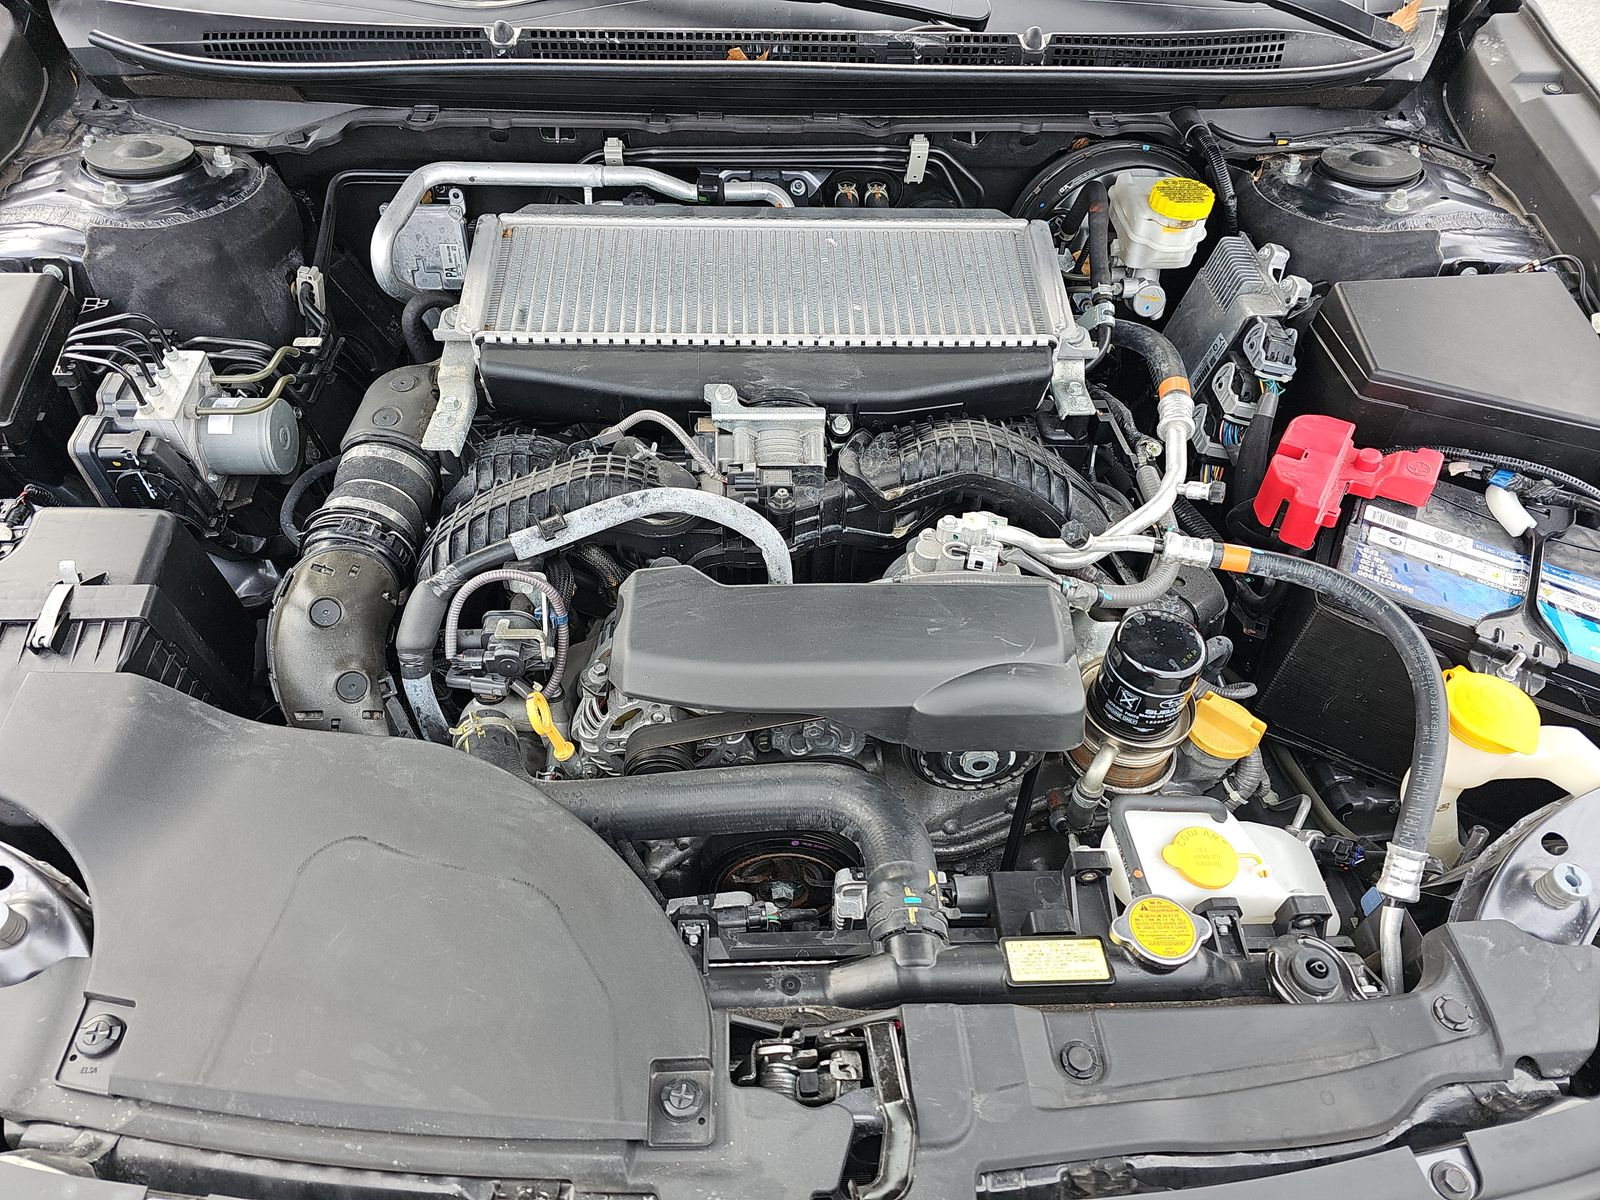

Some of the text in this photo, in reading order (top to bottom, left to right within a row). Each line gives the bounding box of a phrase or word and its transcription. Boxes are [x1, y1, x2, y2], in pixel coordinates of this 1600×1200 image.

[444, 267, 457, 277] PA
[1360, 558, 1375, 567] 120
[1376, 570, 1392, 580] CCA
[1336, 577, 1379, 608] NICHIRIN
[1398, 754, 1435, 849] ICHIRIN HYLAMMIT
[80, 1066, 98, 1074] ELSA
